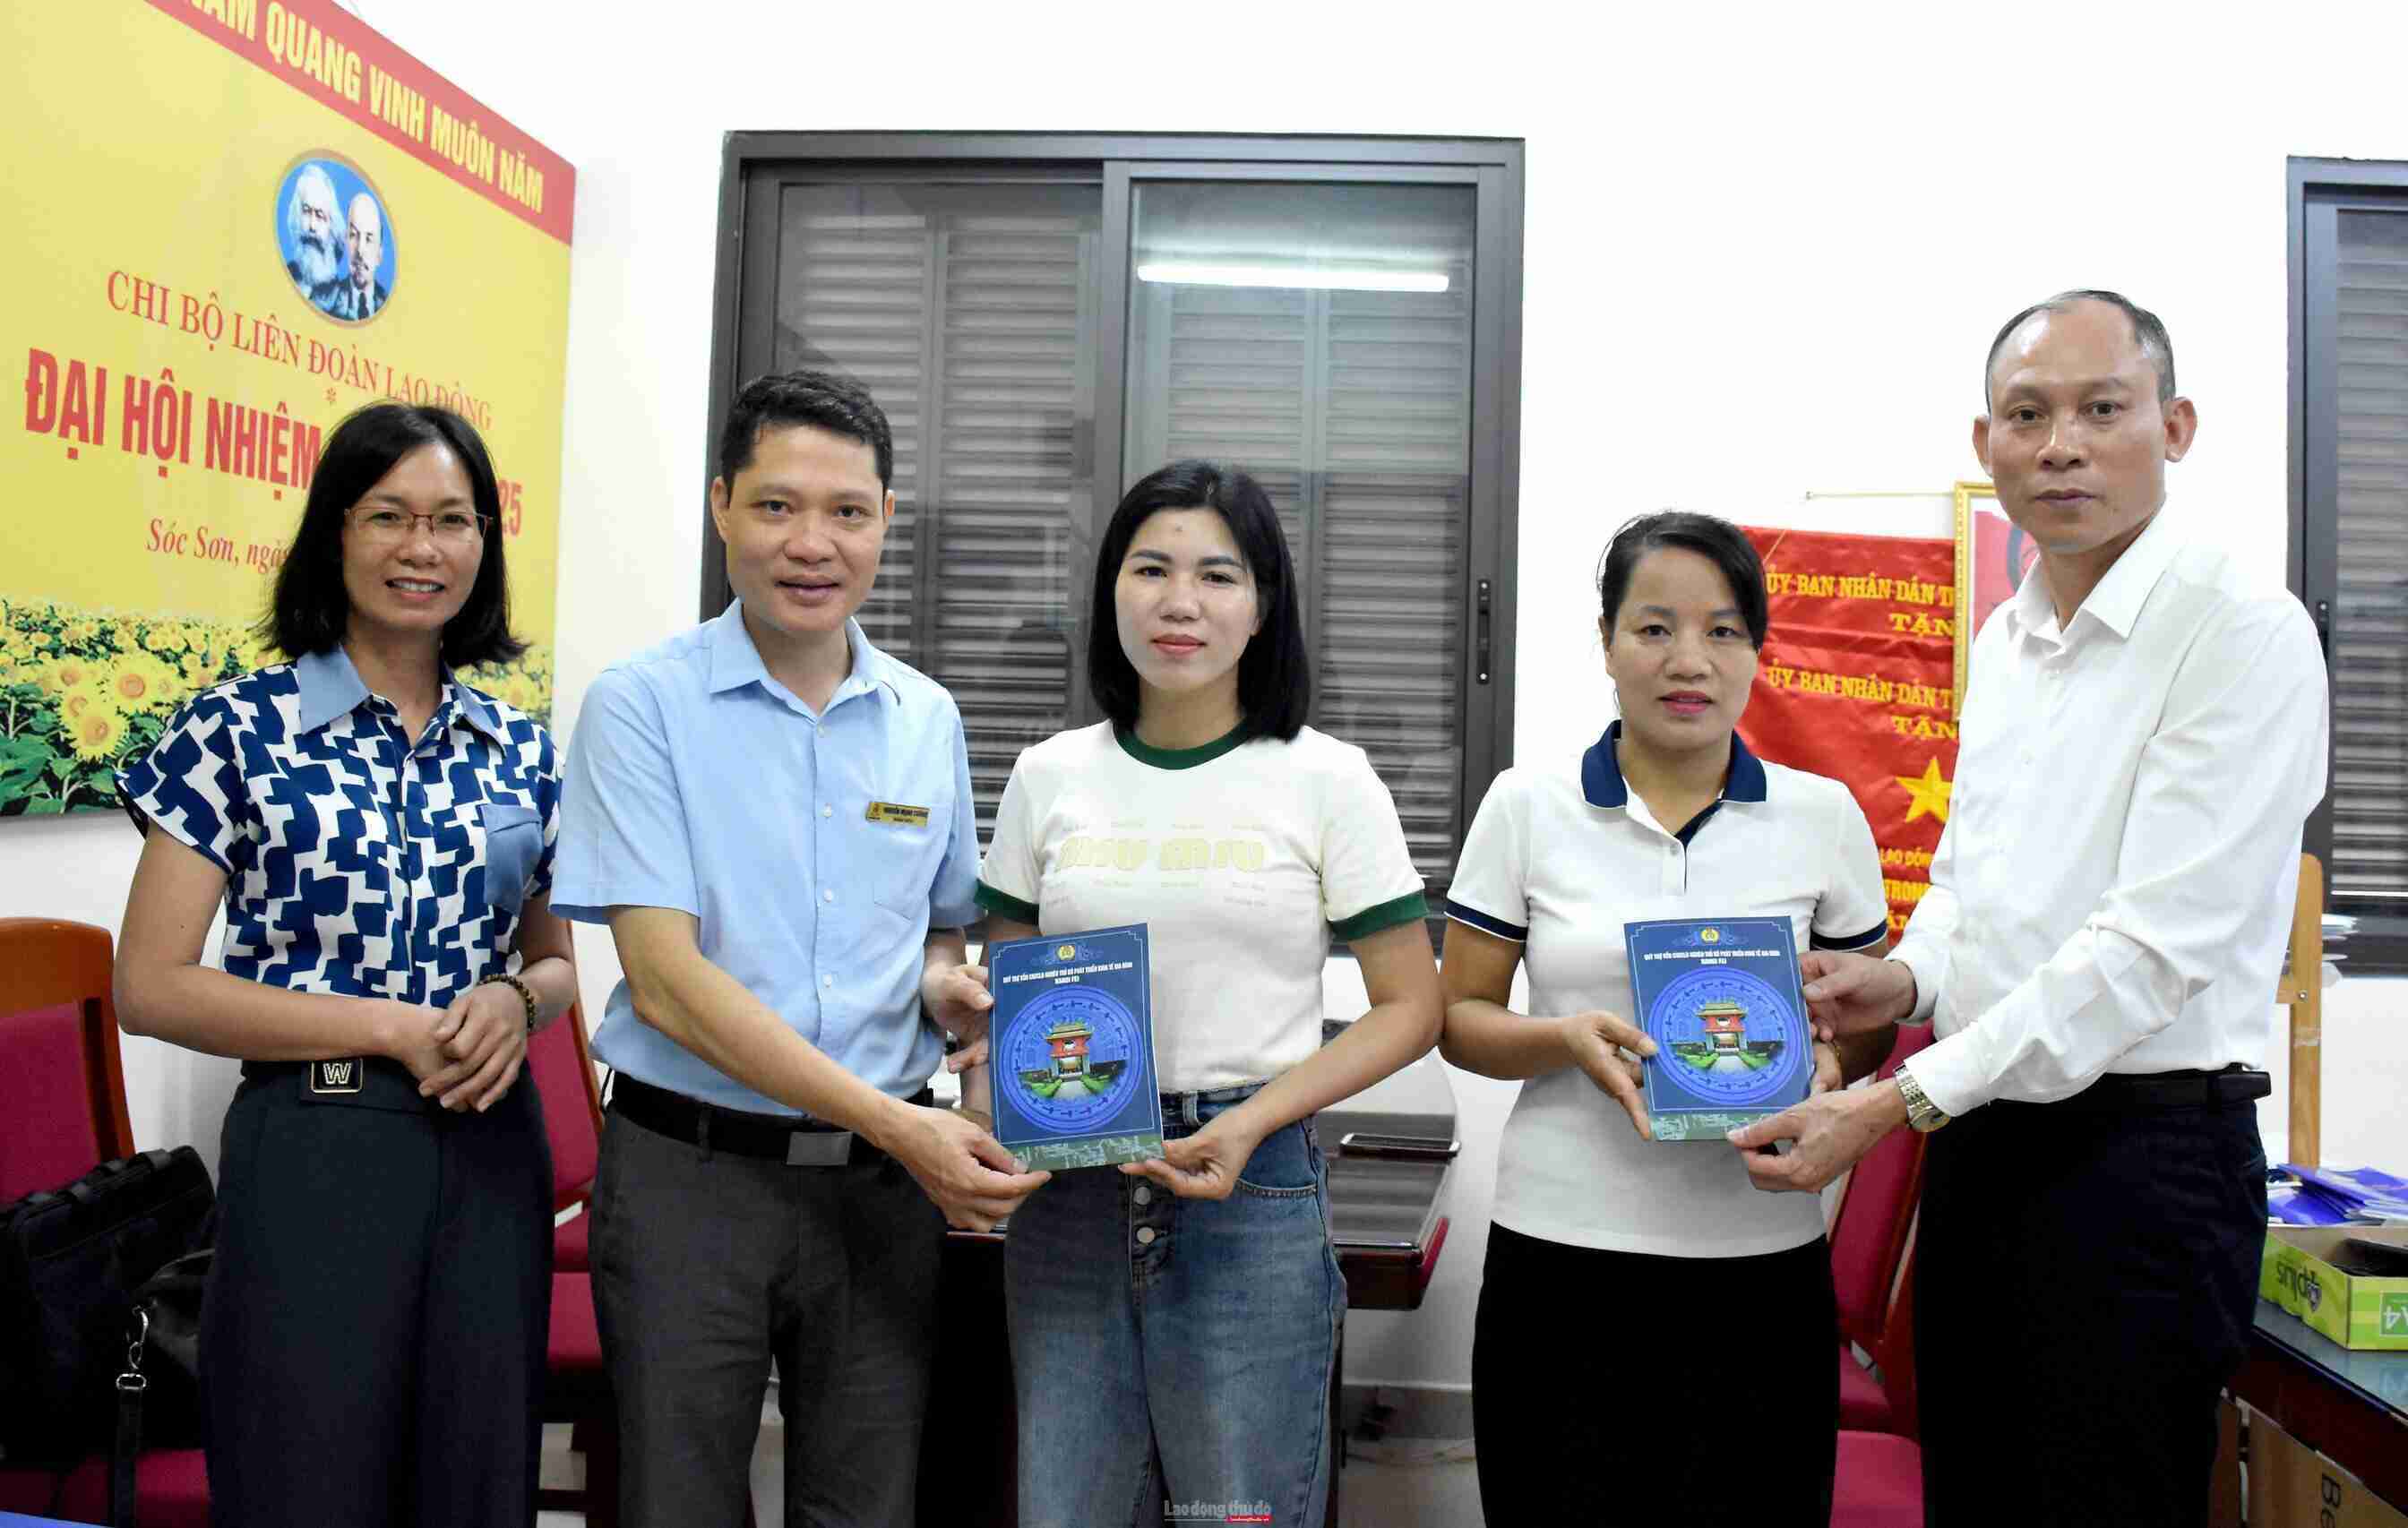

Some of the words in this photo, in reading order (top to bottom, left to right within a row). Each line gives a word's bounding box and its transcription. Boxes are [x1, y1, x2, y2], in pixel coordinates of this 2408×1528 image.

[266, 2, 362, 104] QUANG
[370, 64, 426, 143] VINH
[430, 104, 495, 185] MUÔN
[499, 149, 544, 215] NĂM
[108, 270, 170, 325] CHI
[179, 291, 223, 352] BỘ
[231, 312, 301, 368] LIÊN
[308, 339, 379, 394] ĐOÀN
[386, 366, 430, 408] LAO
[24, 347, 108, 460] ĐẠI
[122, 366, 194, 479] HỘI
[205, 397, 321, 502] NHIỆM
[147, 518, 188, 555] Sóc
[194, 525, 239, 567] Sơn,
[1766, 563, 1792, 596] ỦY
[1796, 574, 1836, 597] BAN
[1839, 571, 1893, 599] NHÂN
[1896, 575, 1935, 605] DÂN
[1767, 657, 1793, 689] ỦY
[1800, 671, 1836, 695] BAN
[1842, 673, 1893, 702] NHÂN
[1896, 678, 1936, 708] DÂN
[323, 1062, 352, 1085] W
